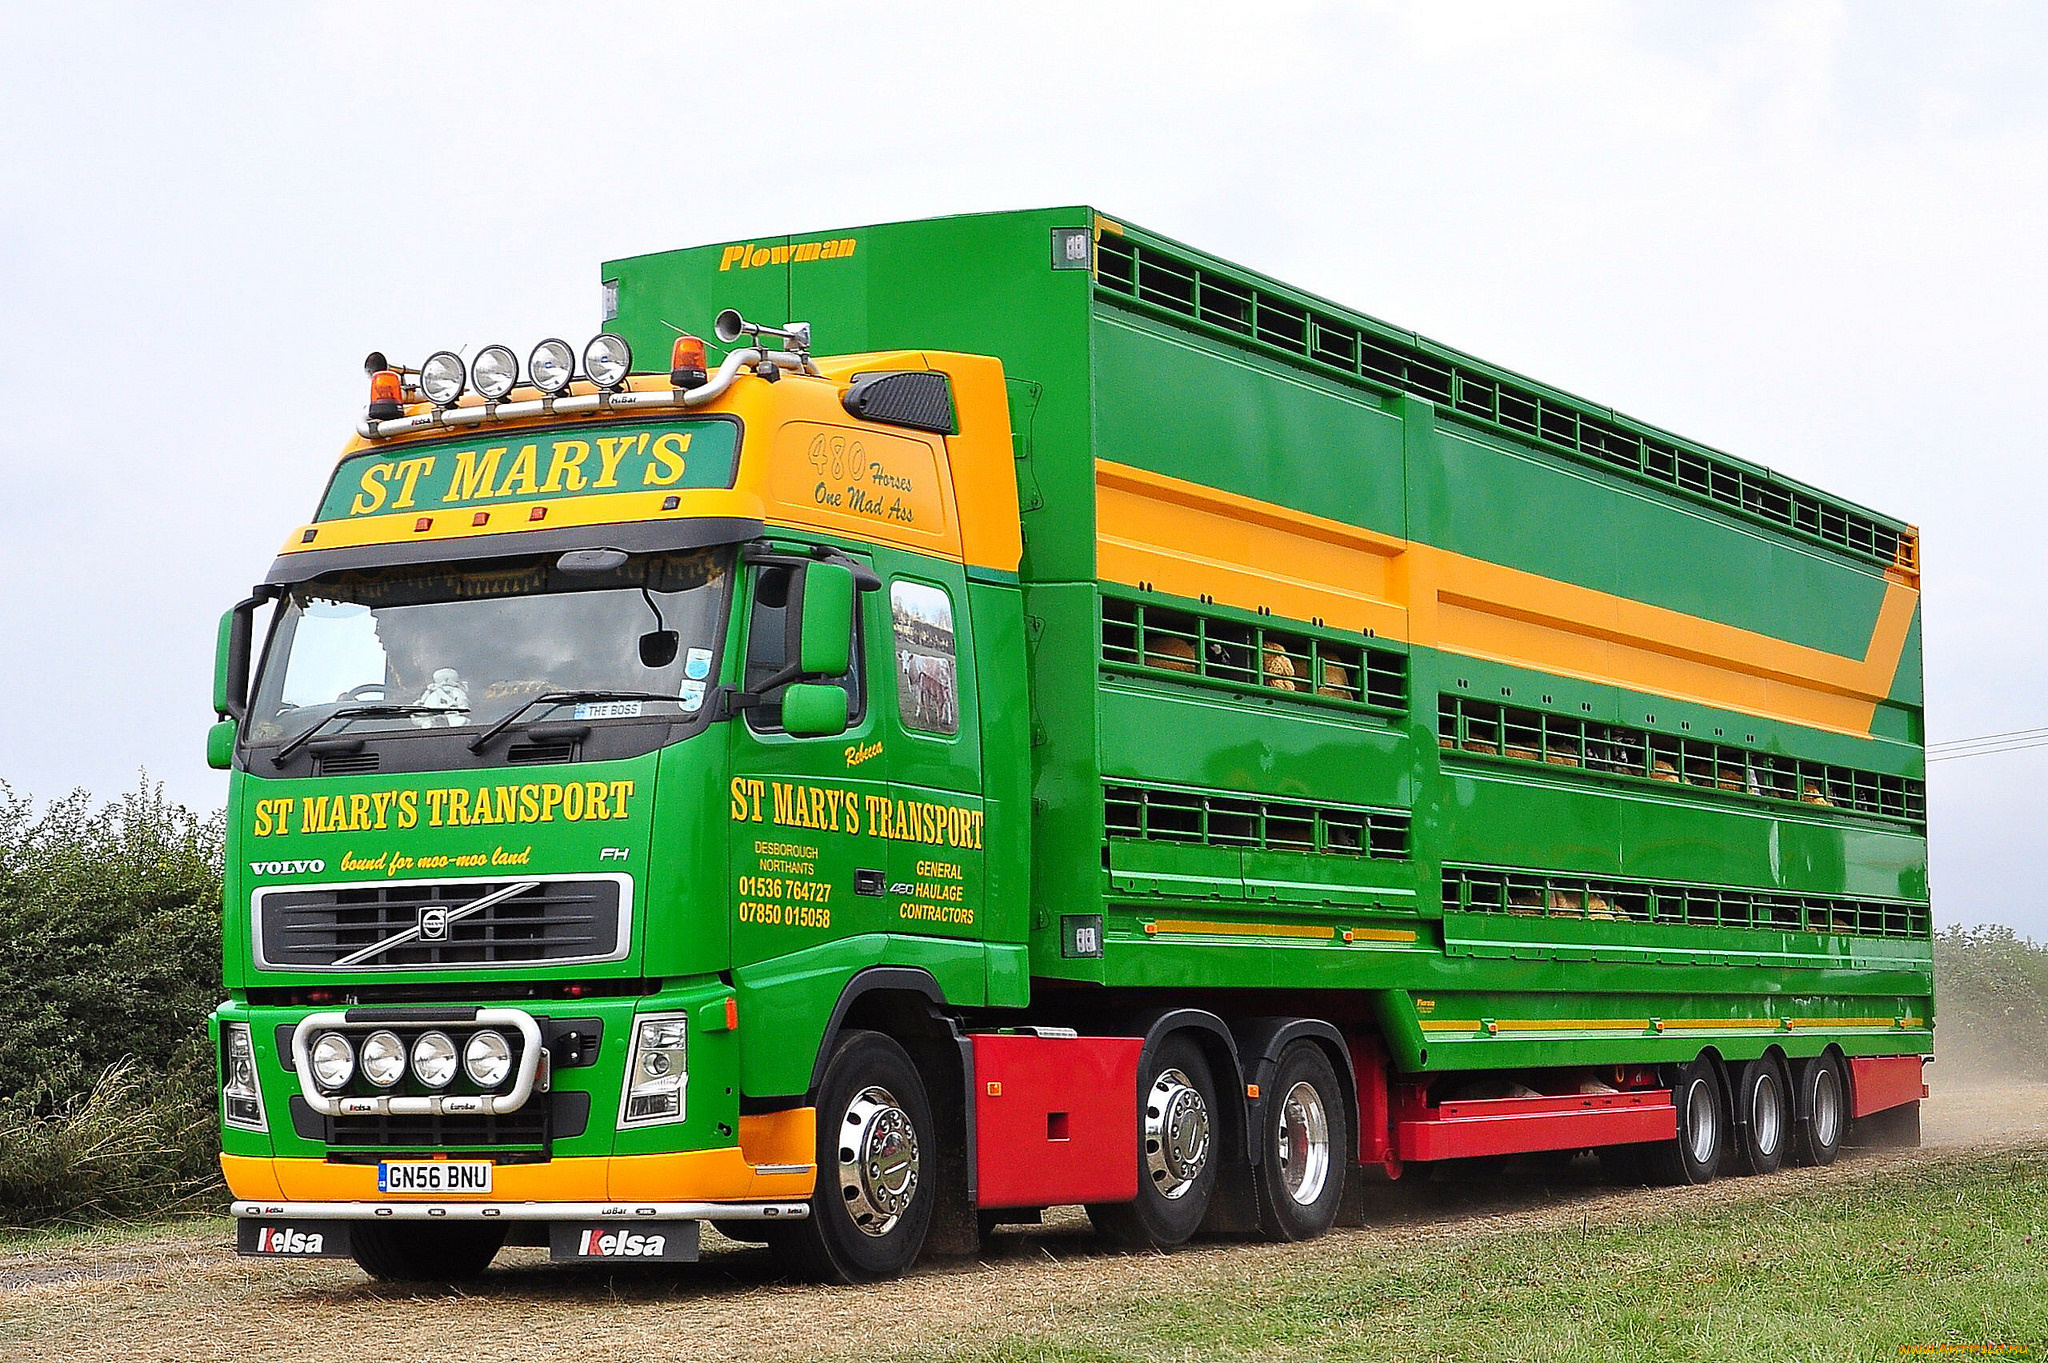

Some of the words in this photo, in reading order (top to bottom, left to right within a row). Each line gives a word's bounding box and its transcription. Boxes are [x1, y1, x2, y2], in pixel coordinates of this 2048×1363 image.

[719, 238, 857, 272] Plowman
[350, 456, 436, 515] ST
[443, 432, 692, 503] MARY'S
[808, 433, 866, 481] 480
[869, 462, 913, 492] Horses
[815, 481, 842, 506] One
[847, 486, 884, 515] Mad
[887, 497, 914, 522] Ass
[588, 705, 607, 716] THE
[611, 704, 638, 715] BOSS
[254, 798, 294, 836] ST
[301, 789, 419, 833] MARY'S
[426, 781, 634, 827] TRANSPORT
[731, 777, 765, 822] ST
[772, 782, 860, 834] MARY'S
[865, 795, 984, 850] TRANSPORT
[341, 851, 388, 871] bound
[387, 851, 415, 876] for
[417, 853, 488, 868] moo-moo
[491, 846, 531, 866] land
[600, 848, 630, 861] FH
[755, 841, 818, 859] DESBOROUGH
[250, 858, 326, 875] VOLVO
[759, 858, 814, 875] NORTHANTS
[916, 860, 963, 880] GENERAL
[739, 875, 782, 899] 01536
[785, 879, 832, 903] 764727
[915, 882, 964, 901] HAULAGE
[739, 902, 781, 925] 07850
[784, 905, 830, 928] 015058
[900, 902, 974, 925] CONTRACTORS
[389, 1166, 441, 1188] GN56
[447, 1166, 487, 1188] BNU
[257, 1227, 324, 1253] Kelsa
[577, 1229, 666, 1257] Kelsa
